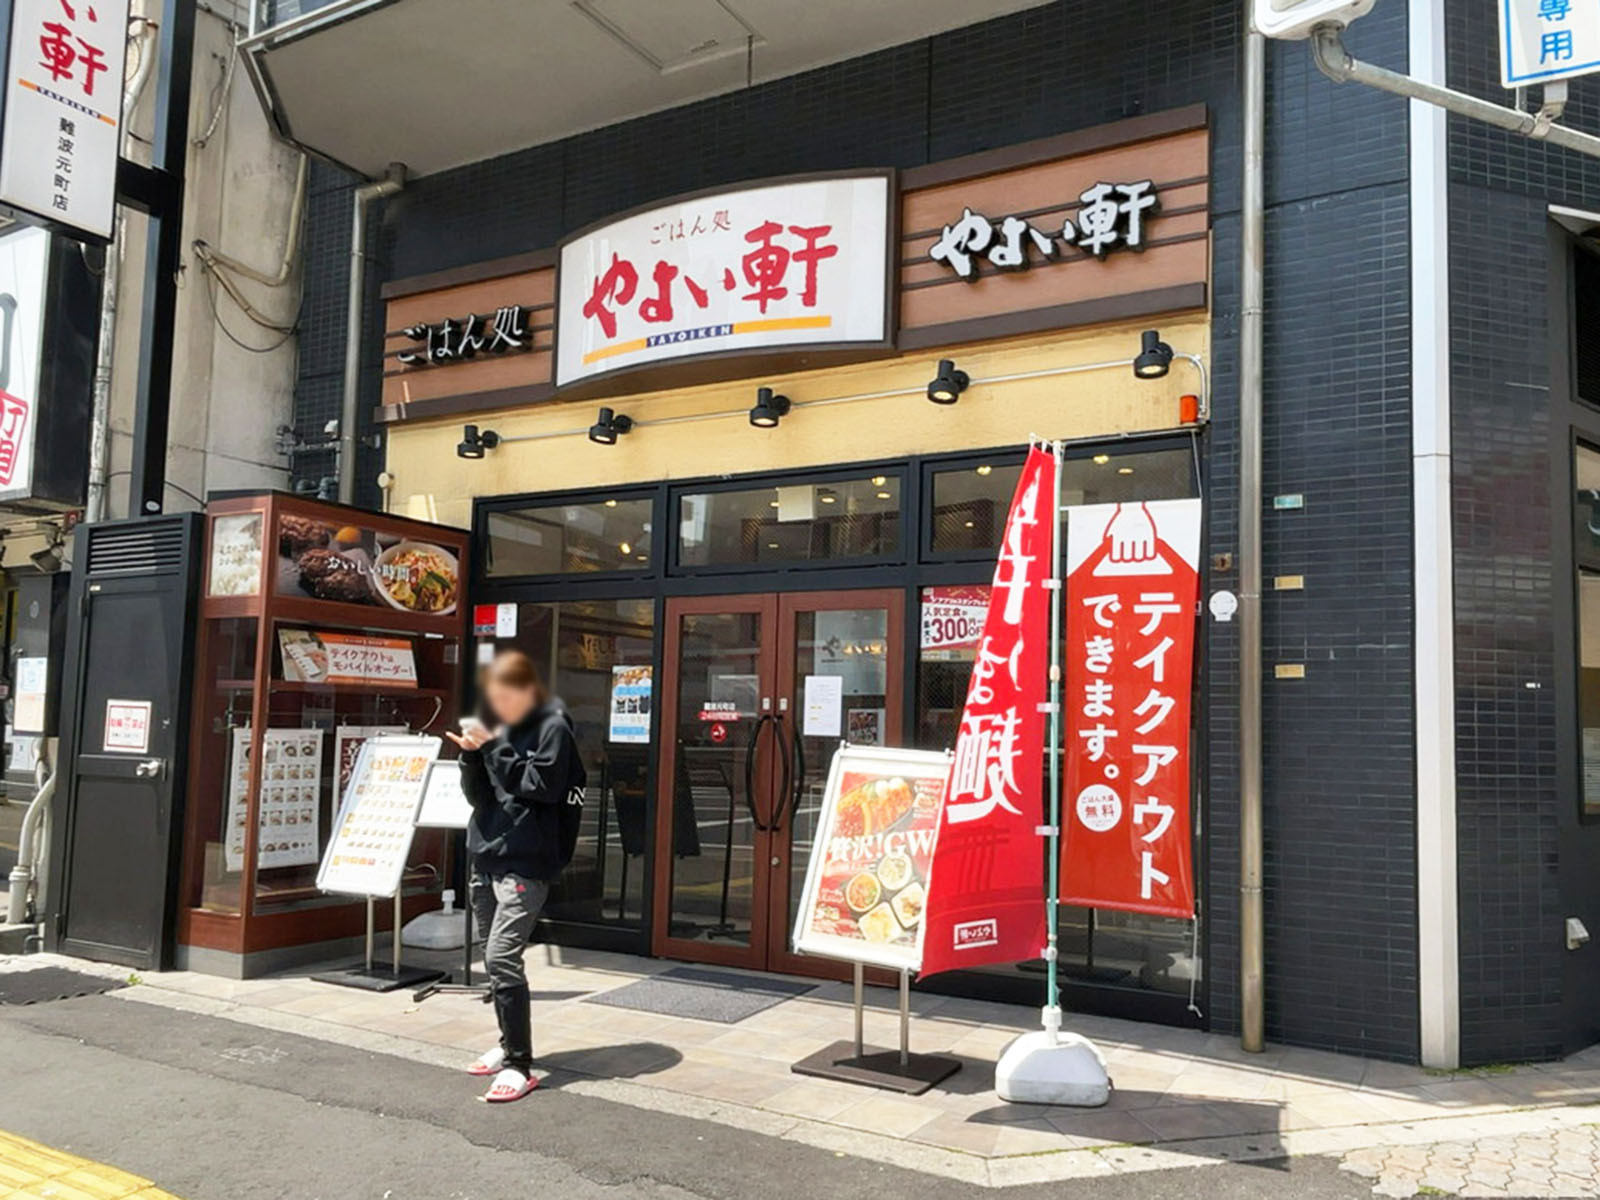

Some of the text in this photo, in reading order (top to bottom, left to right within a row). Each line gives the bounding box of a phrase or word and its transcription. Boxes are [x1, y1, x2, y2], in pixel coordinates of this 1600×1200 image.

[52, 117, 76, 211] 難波元町店
[650, 209, 731, 245] ごはん処
[929, 180, 1156, 277] やよい軒
[583, 220, 839, 339] やよい軒
[397, 305, 523, 362] ごはん処
[650, 324, 731, 347] YAYOIKEN
[330, 648, 394, 662] テイクアウトは
[931, 617, 968, 643] 300
[1079, 594, 1122, 779] できます。
[1132, 592, 1182, 899] テイクアウト
[1085, 804, 1114, 818] 無料
